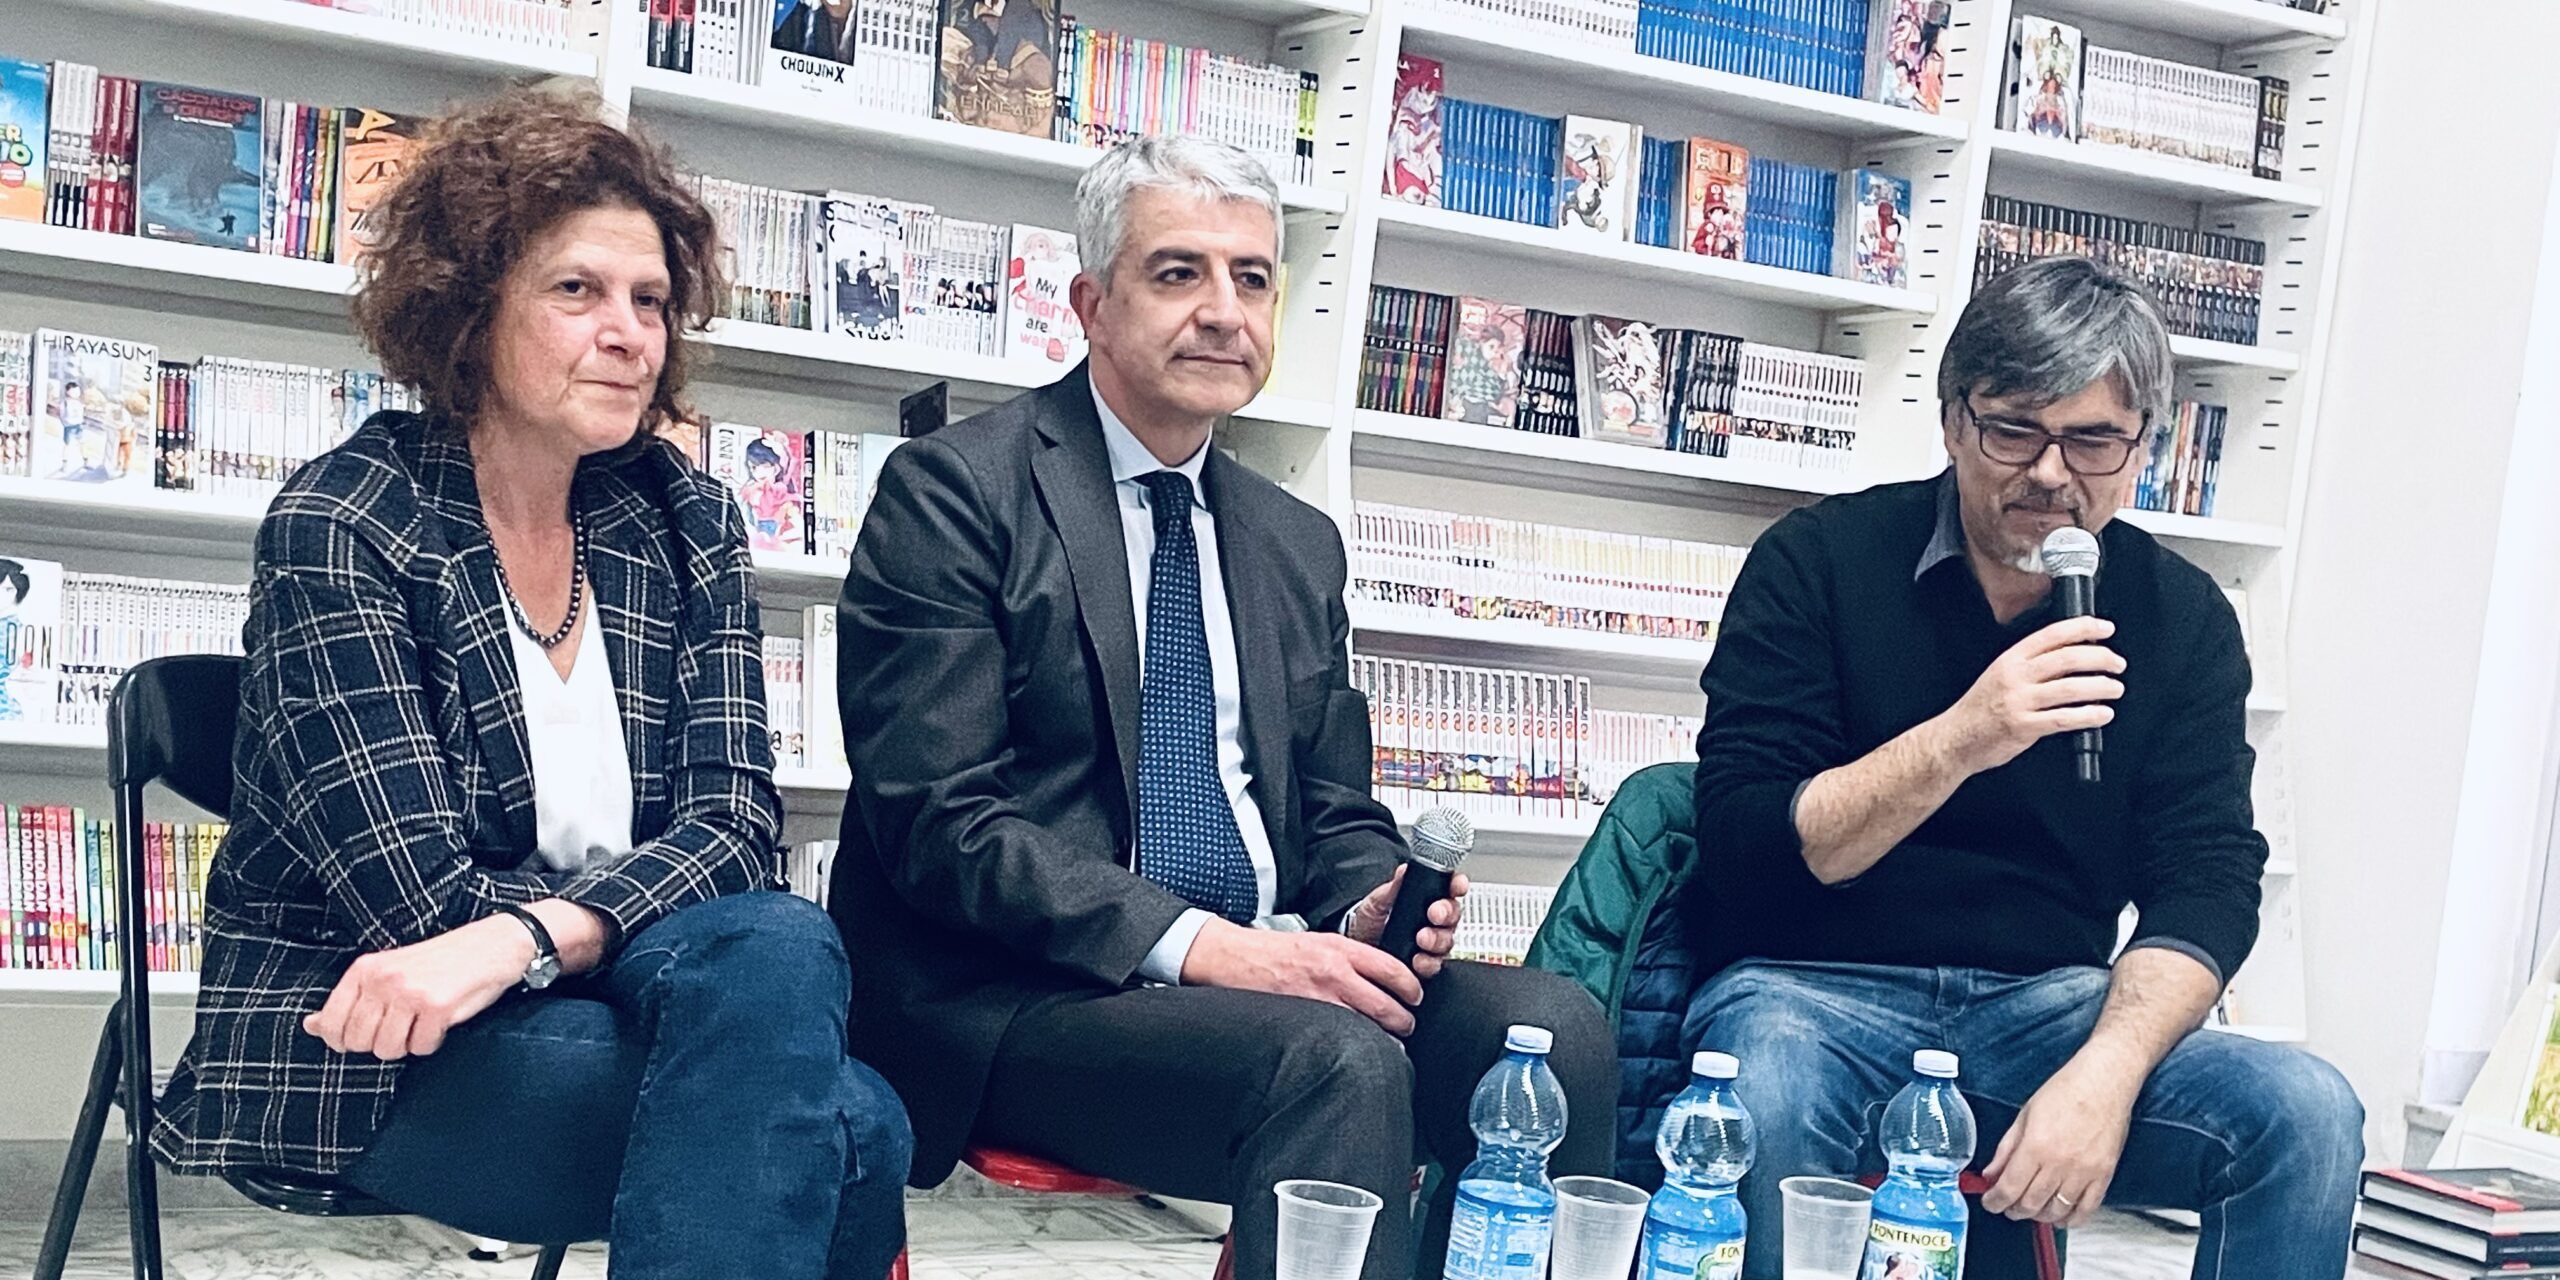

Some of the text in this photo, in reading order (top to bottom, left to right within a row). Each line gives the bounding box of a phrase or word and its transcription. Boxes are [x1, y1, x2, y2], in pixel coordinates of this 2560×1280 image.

[781, 56, 845, 84] CHOUJIN X
[1035, 277, 1058, 299] My
[1025, 317, 1049, 333] are
[43, 334, 158, 363] HIRAYASUMI
[143, 364, 153, 383] 3
[1874, 1223, 1947, 1247] FONTENOCE
